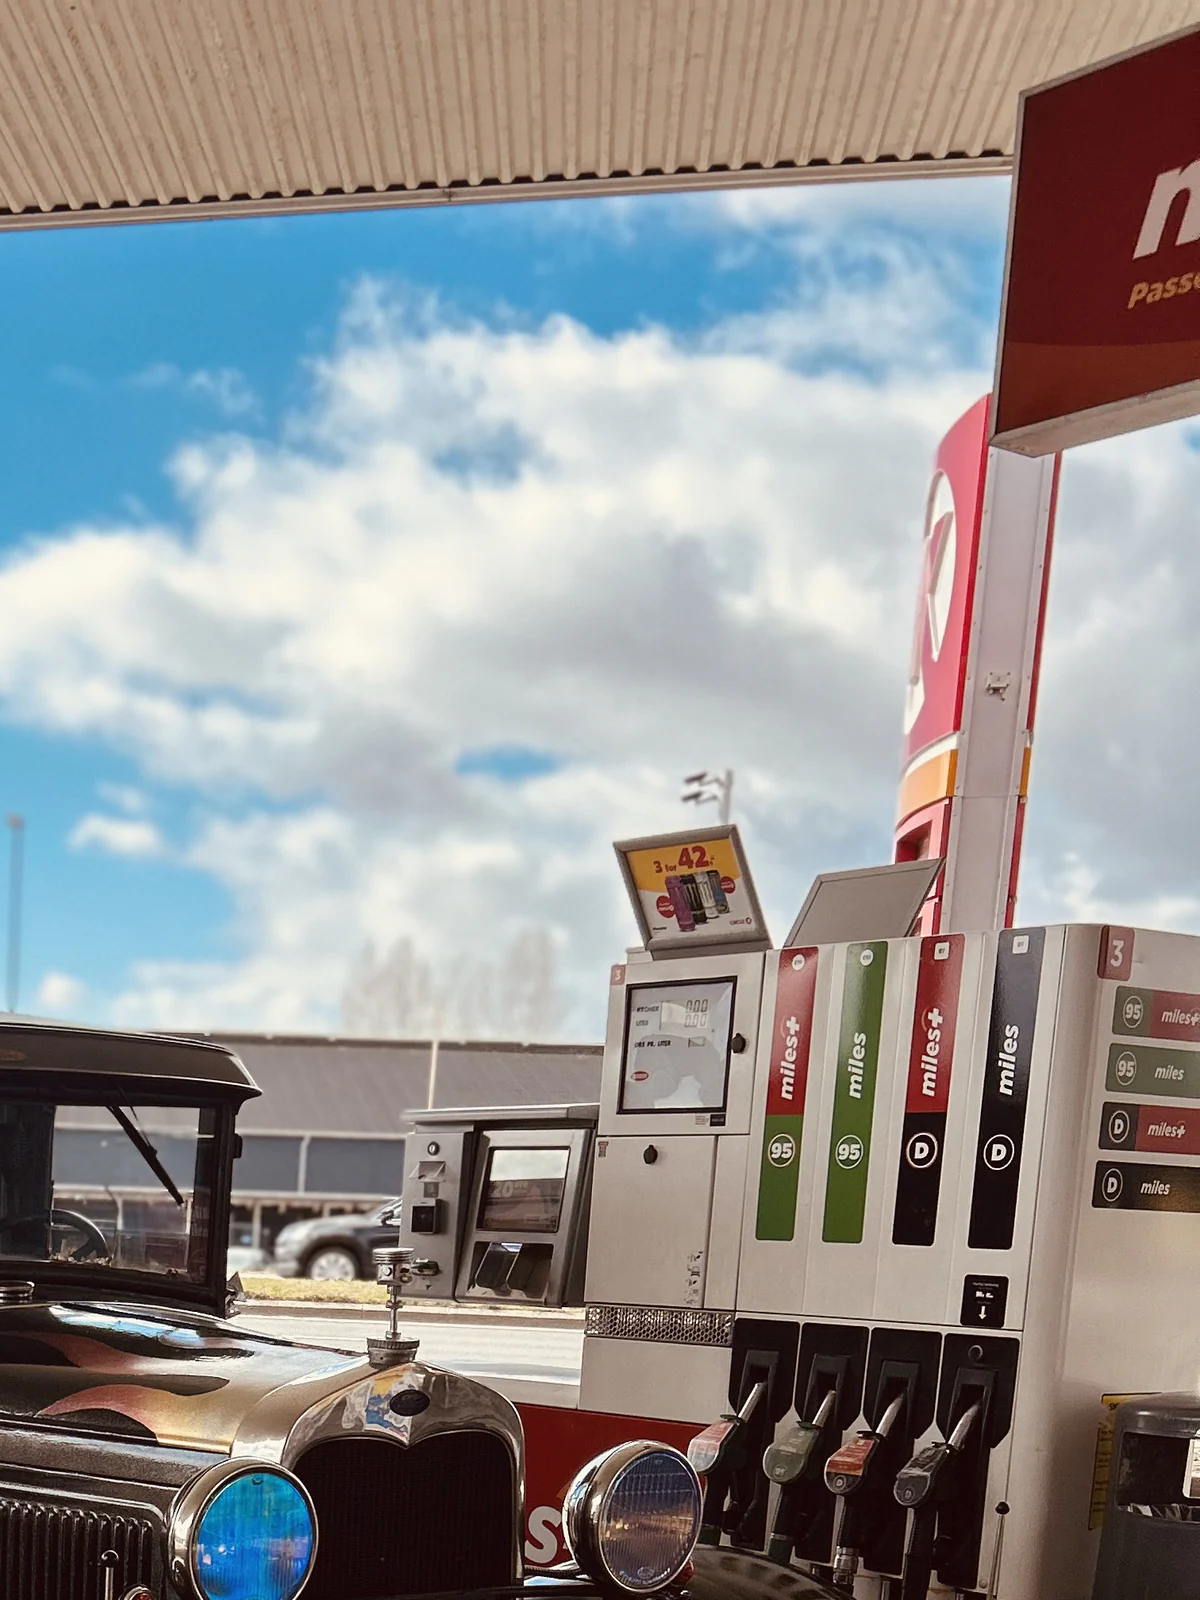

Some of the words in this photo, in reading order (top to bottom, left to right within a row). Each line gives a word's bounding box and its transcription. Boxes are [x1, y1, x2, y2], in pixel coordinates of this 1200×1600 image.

[653, 860, 663, 873] 3
[665, 864, 677, 873] for
[1110, 939, 1125, 968] 3
[614, 969, 622, 981] 3
[1125, 1003, 1142, 1020] 95
[847, 1032, 867, 1100] miles
[998, 1024, 1020, 1096] miles
[1117, 1060, 1135, 1078] 95
[1154, 1064, 1185, 1081] miles
[1113, 1117, 1123, 1135] D
[770, 1142, 793, 1159] 95
[837, 1143, 861, 1161] 95
[914, 1142, 929, 1159] D
[990, 1144, 1007, 1161] D
[1106, 1176, 1117, 1194] D
[1140, 1179, 1171, 1196] miles
